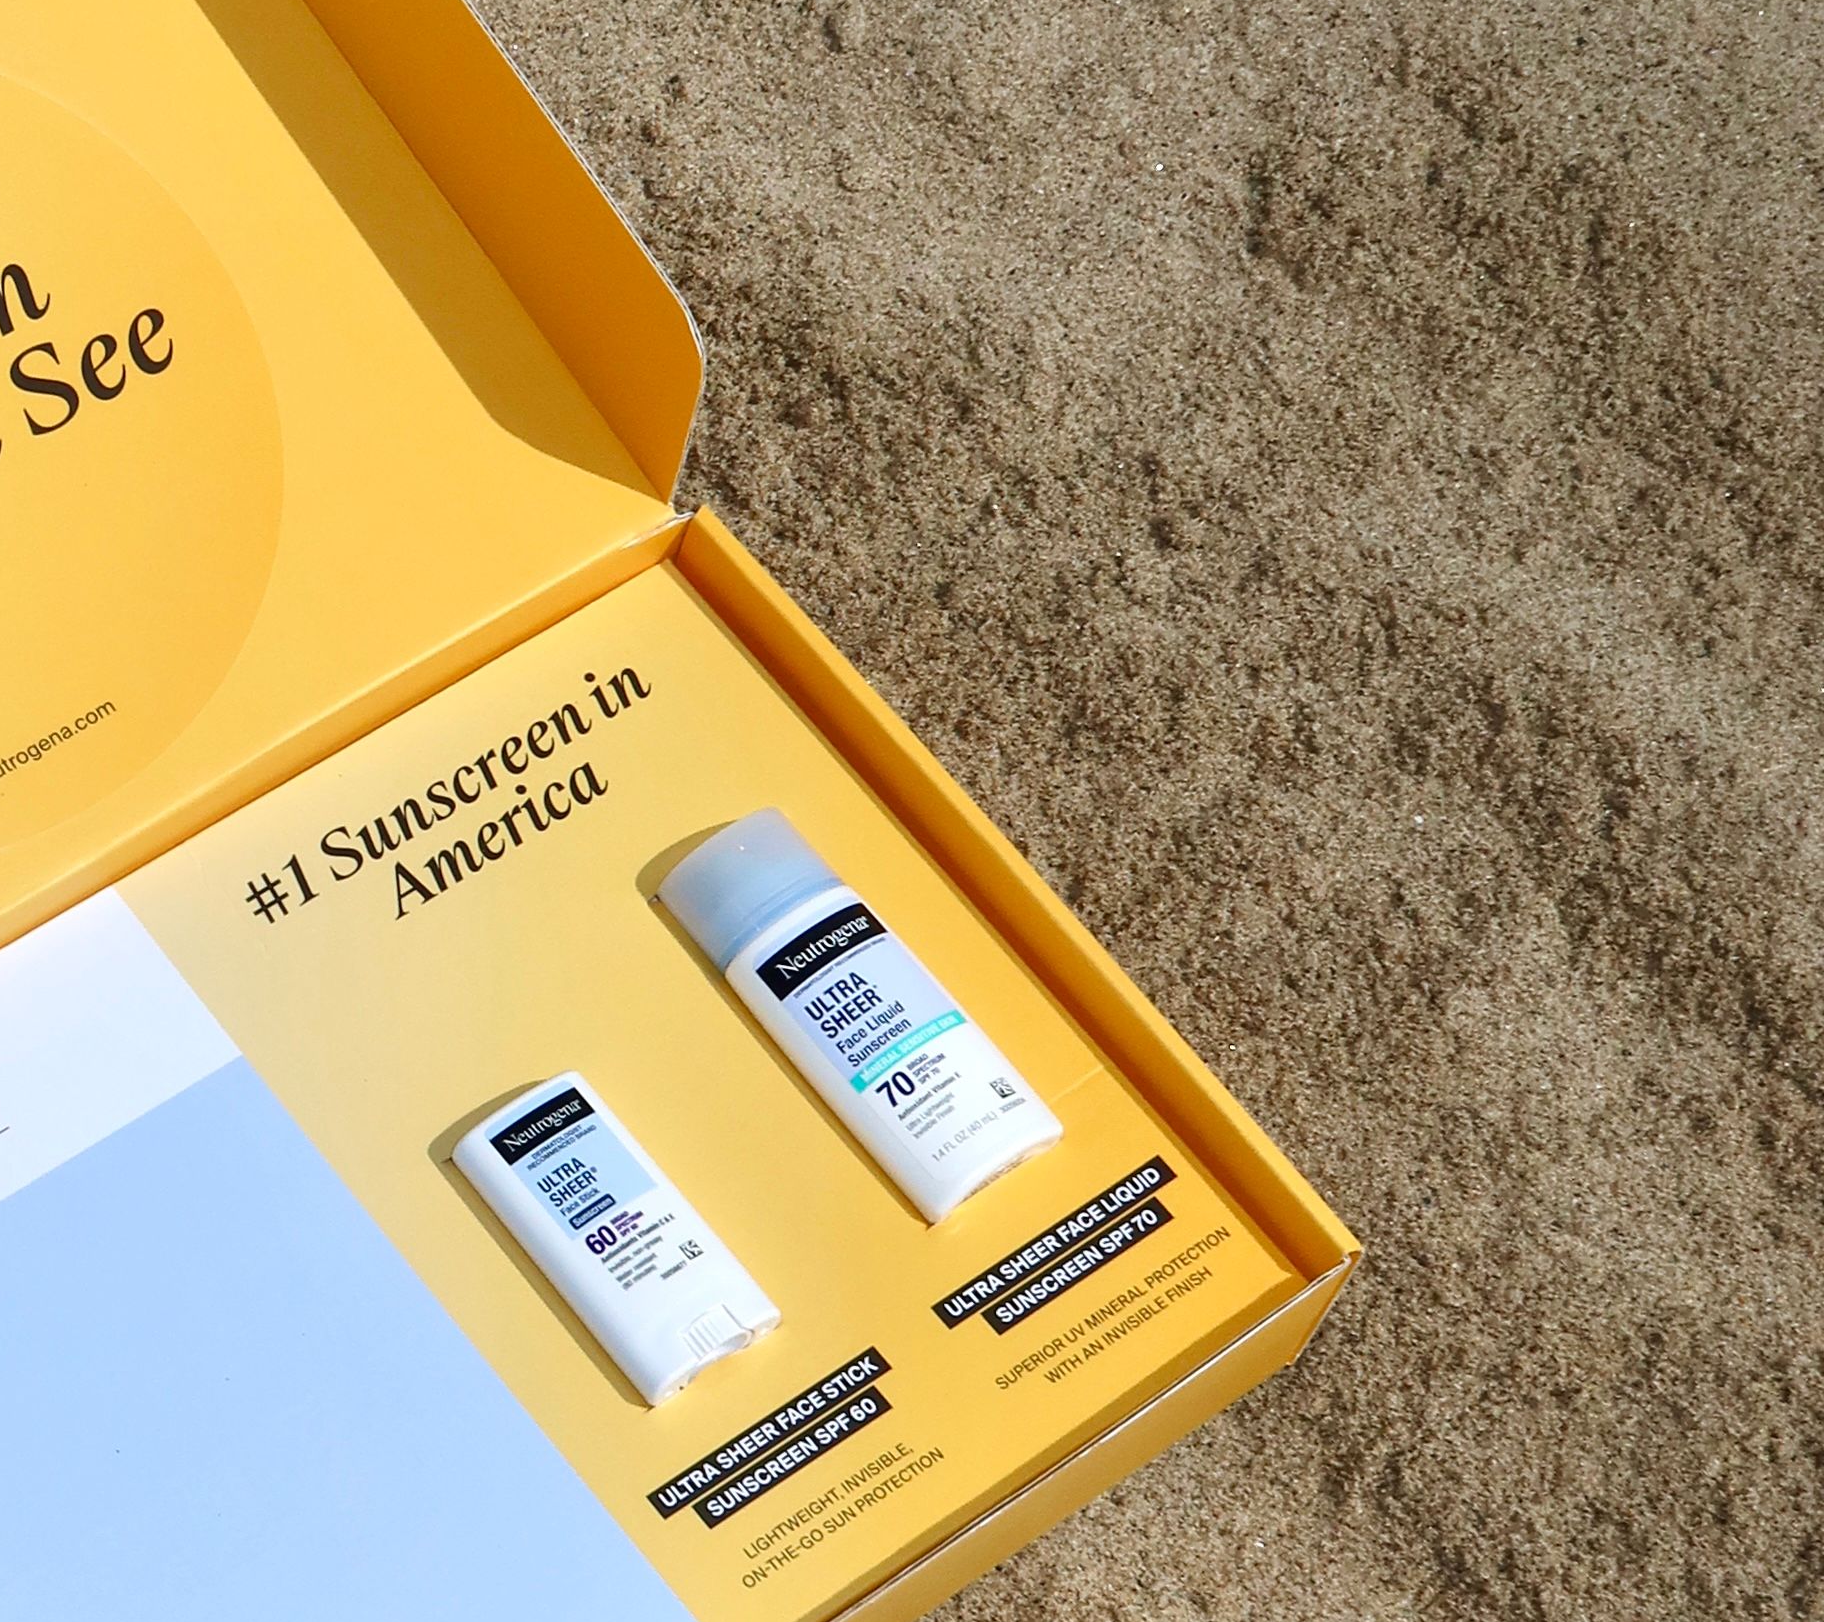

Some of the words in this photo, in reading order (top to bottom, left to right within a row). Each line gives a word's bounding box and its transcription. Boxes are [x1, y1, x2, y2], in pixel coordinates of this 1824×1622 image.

[9, 308, 174, 435] See
[245, 854, 319, 924] #1
[320, 703, 591, 880] Sunscreen
[583, 667, 651, 718] in
[395, 762, 608, 920] America
[775, 915, 870, 979] Neutrogena
[803, 972, 869, 1021] ULTRA
[819, 986, 883, 1039] SHEER
[835, 1028, 868, 1055] Face
[864, 1000, 906, 1031] Liquid
[847, 1017, 912, 1067] Sunscreen
[859, 1050, 900, 1083] MINERAL
[875, 1071, 916, 1107] 70
[502, 1099, 582, 1152] Neutrogena
[537, 1157, 587, 1193] ULTRA
[560, 1200, 580, 1217] Face
[578, 1187, 600, 1203] Stick
[574, 1198, 613, 1227] Sunscreen
[585, 1225, 618, 1255] 60
[944, 1278, 1005, 1317] ULTRA
[999, 1235, 1061, 1281] SHEER
[1056, 1204, 1106, 1244] FACE
[1100, 1167, 1161, 1214] LIQUID
[995, 1246, 1104, 1323] SUNSCREEN
[1099, 1223, 1135, 1253] SPF
[1131, 1208, 1158, 1232] 70
[995, 1339, 1066, 1390] SUPERIOR
[1063, 1324, 1086, 1344] UV
[1084, 1287, 1147, 1330] MINERAL
[1144, 1226, 1231, 1289] PROTECTION
[1044, 1352, 1084, 1384] WITH
[1085, 1339, 1105, 1360] AN
[1105, 1296, 1166, 1346] INVISIBLE
[1165, 1266, 1213, 1303] FINISH
[657, 1462, 721, 1508] ULTRA
[716, 1423, 780, 1470] SHEER
[775, 1391, 826, 1430] FACE
[822, 1356, 879, 1400] STICK
[706, 1437, 818, 1517] SUNSCREEN
[815, 1412, 851, 1444] SPF
[849, 1397, 877, 1421] 60
[742, 1528, 824, 1589] ON-THE-GO
[824, 1504, 857, 1534] SUN
[855, 1447, 945, 1512] PROTECTION
[743, 1487, 845, 1559] LIGHTWEIGHT,
[841, 1442, 914, 1495] INVISIBLE,
